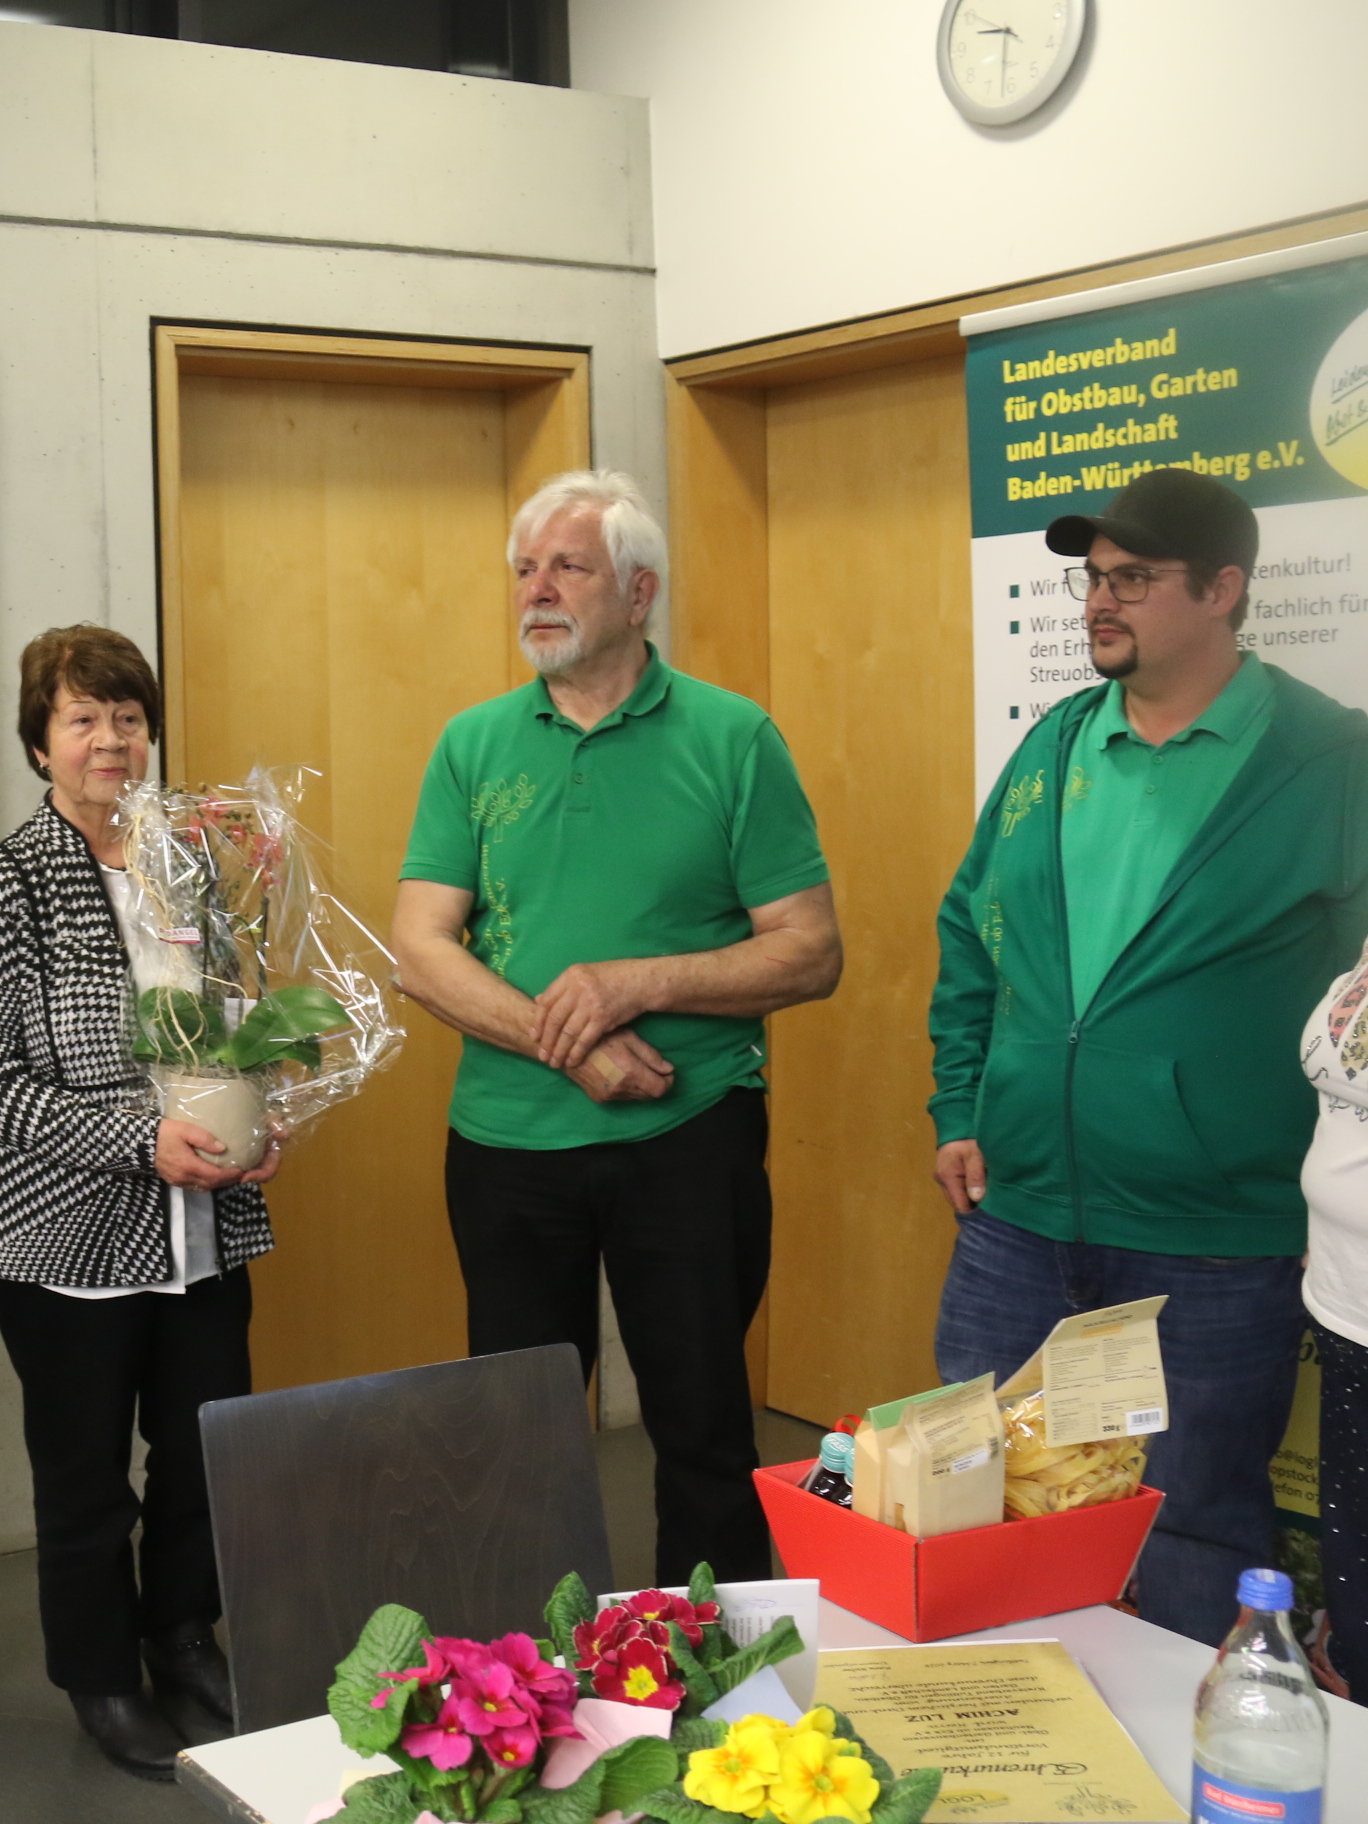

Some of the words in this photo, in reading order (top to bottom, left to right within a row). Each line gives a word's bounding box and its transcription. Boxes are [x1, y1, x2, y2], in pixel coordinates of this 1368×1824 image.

[956, 42, 967, 58] 9
[967, 67, 976, 83] 8
[1029, 61, 1039, 78] 5
[985, 79, 994, 95] 7
[1006, 77, 1016, 94] 6
[1003, 327, 1177, 384] Landesverband
[1004, 397, 1037, 423] für
[1040, 380, 1146, 418] Obstbau,
[1150, 366, 1238, 400] Garten
[1006, 431, 1047, 462] und
[1051, 413, 1178, 456] Landschaft
[1007, 451, 1251, 502] Baden-Württberg
[1256, 440, 1305, 471] e.V.
[1030, 579, 1057, 597] Wir
[1252, 552, 1351, 580] tenkultur!
[1030, 616, 1057, 633] Wir
[1062, 614, 1088, 631] set
[1254, 595, 1332, 619] fachlich
[1338, 593, 1368, 614] für
[1030, 640, 1058, 658] den
[1064, 638, 1093, 656] Erh
[1263, 628, 1339, 646] unserer
[1030, 663, 1103, 683] Streuobs
[903, 1713, 945, 1723] LUZ
[954, 1708, 1020, 1719] ACHIM
[901, 1762, 1087, 1777] Ehrenurkue
